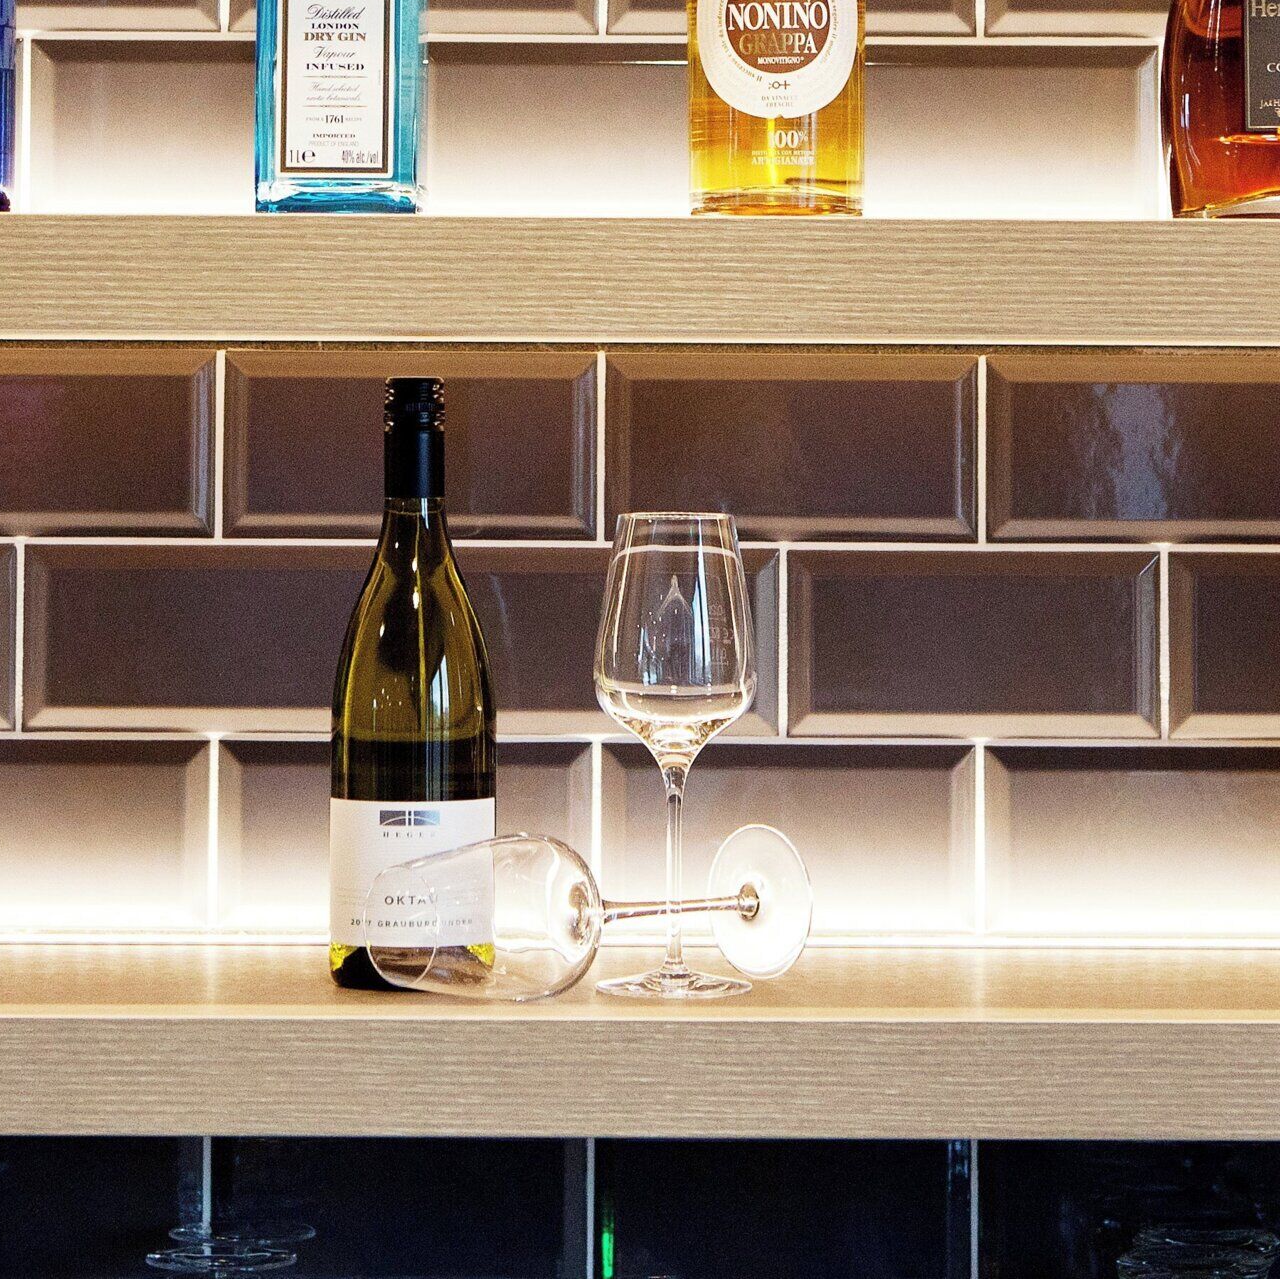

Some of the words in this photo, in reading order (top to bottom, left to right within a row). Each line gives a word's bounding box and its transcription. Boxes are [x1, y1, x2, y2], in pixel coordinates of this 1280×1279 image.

[305, 3, 366, 20] Distilled
[727, 1, 828, 31] NONINO
[304, 32, 335, 41] DRY
[337, 32, 367, 41] GIN
[739, 32, 819, 55] GRAPPA
[313, 45, 356, 62] Vapour
[325, 115, 344, 124] 1761
[767, 129, 809, 149] 100%
[341, 150, 355, 164] 40%
